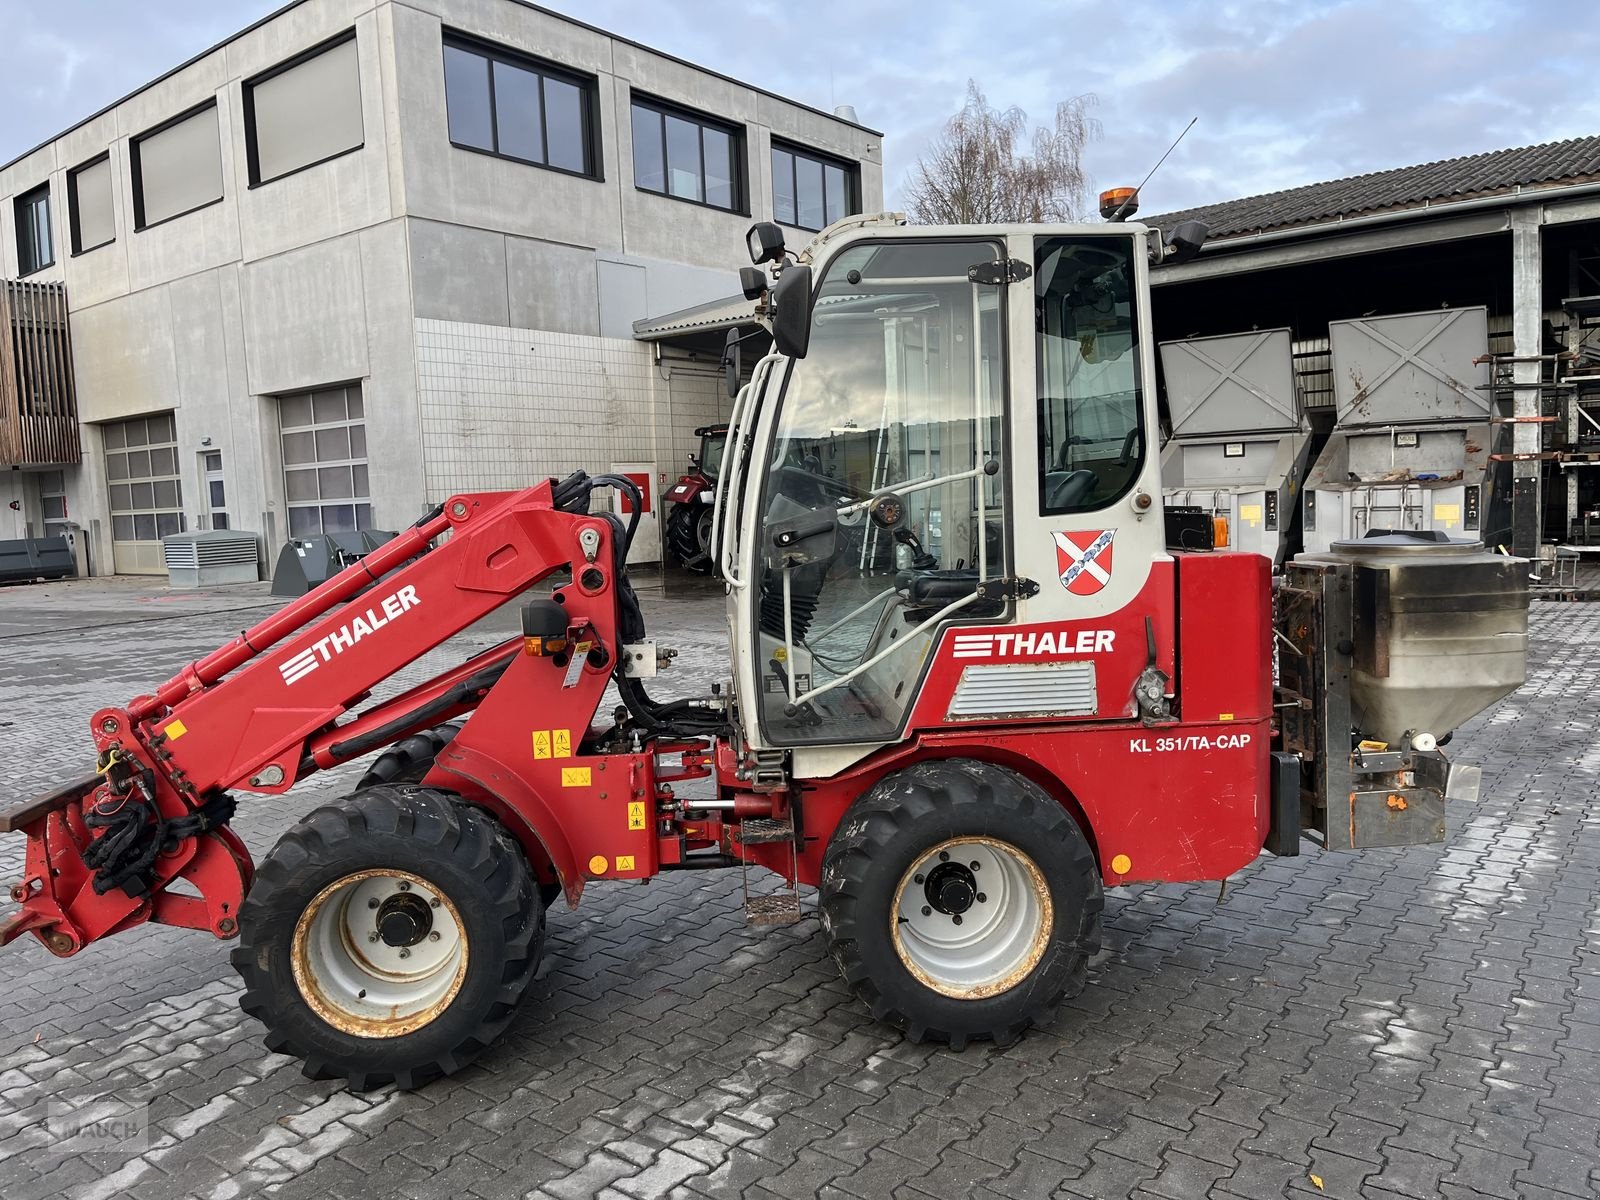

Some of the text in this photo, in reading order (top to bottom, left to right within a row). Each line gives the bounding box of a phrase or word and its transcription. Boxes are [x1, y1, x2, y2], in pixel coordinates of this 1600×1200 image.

[312, 584, 421, 661] THALER
[995, 630, 1116, 656] THALER
[1130, 734, 1251, 752] KL 351/TA-CAP
